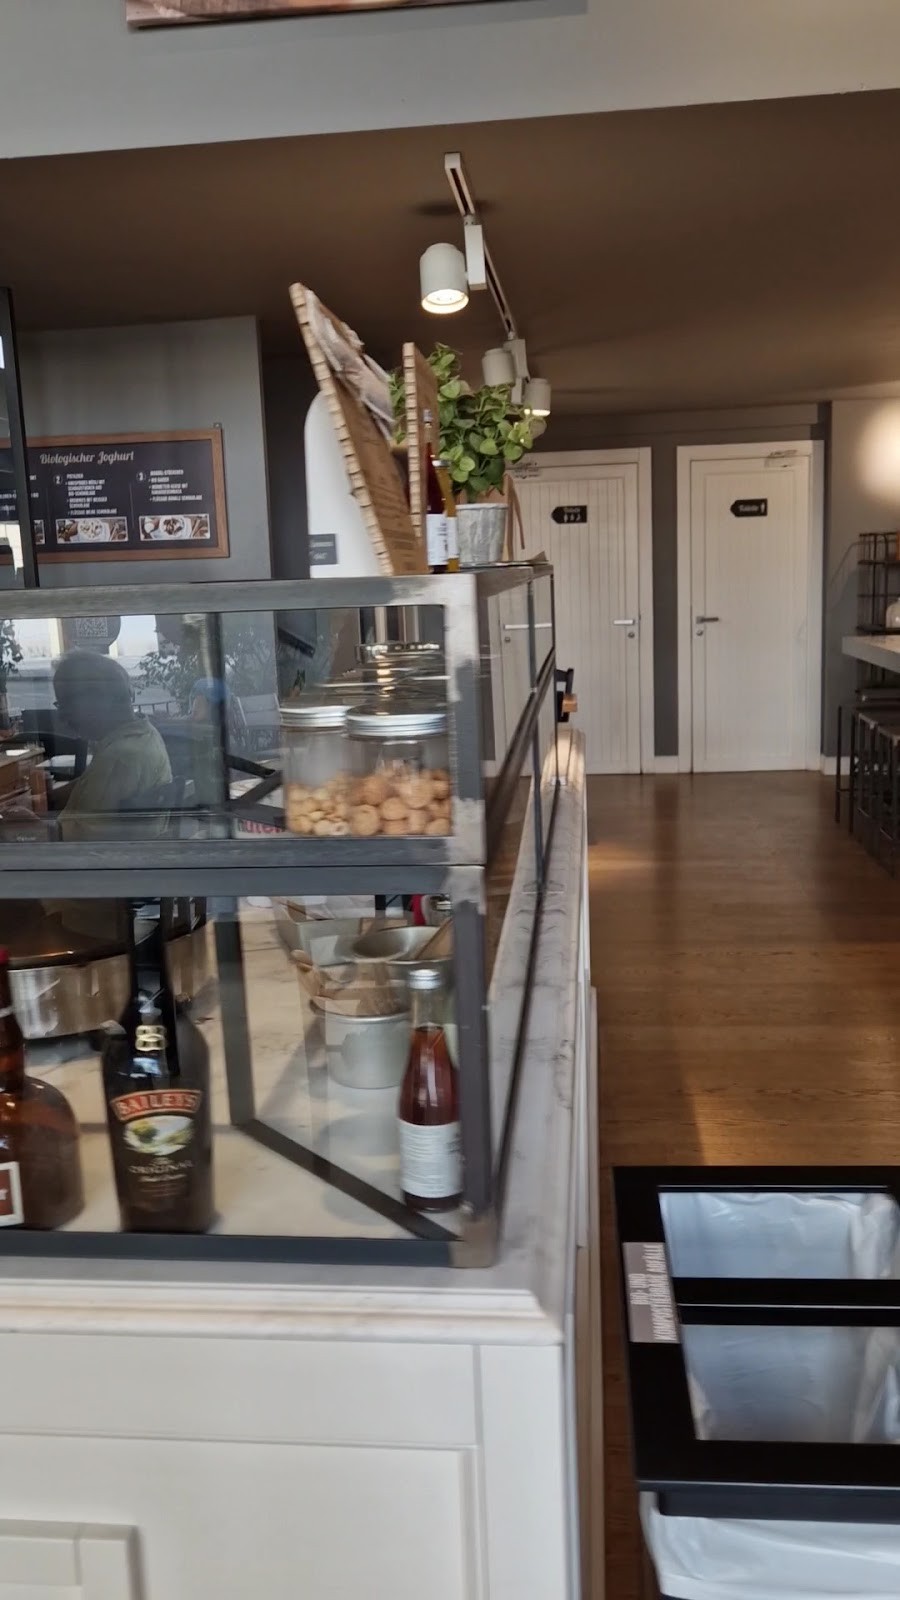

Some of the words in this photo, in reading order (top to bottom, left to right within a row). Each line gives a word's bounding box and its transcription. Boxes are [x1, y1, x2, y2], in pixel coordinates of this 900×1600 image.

[40, 453, 95, 466] Biologischer
[97, 451, 134, 465] Joghurt
[116, 1093, 199, 1115] BAILEYS
